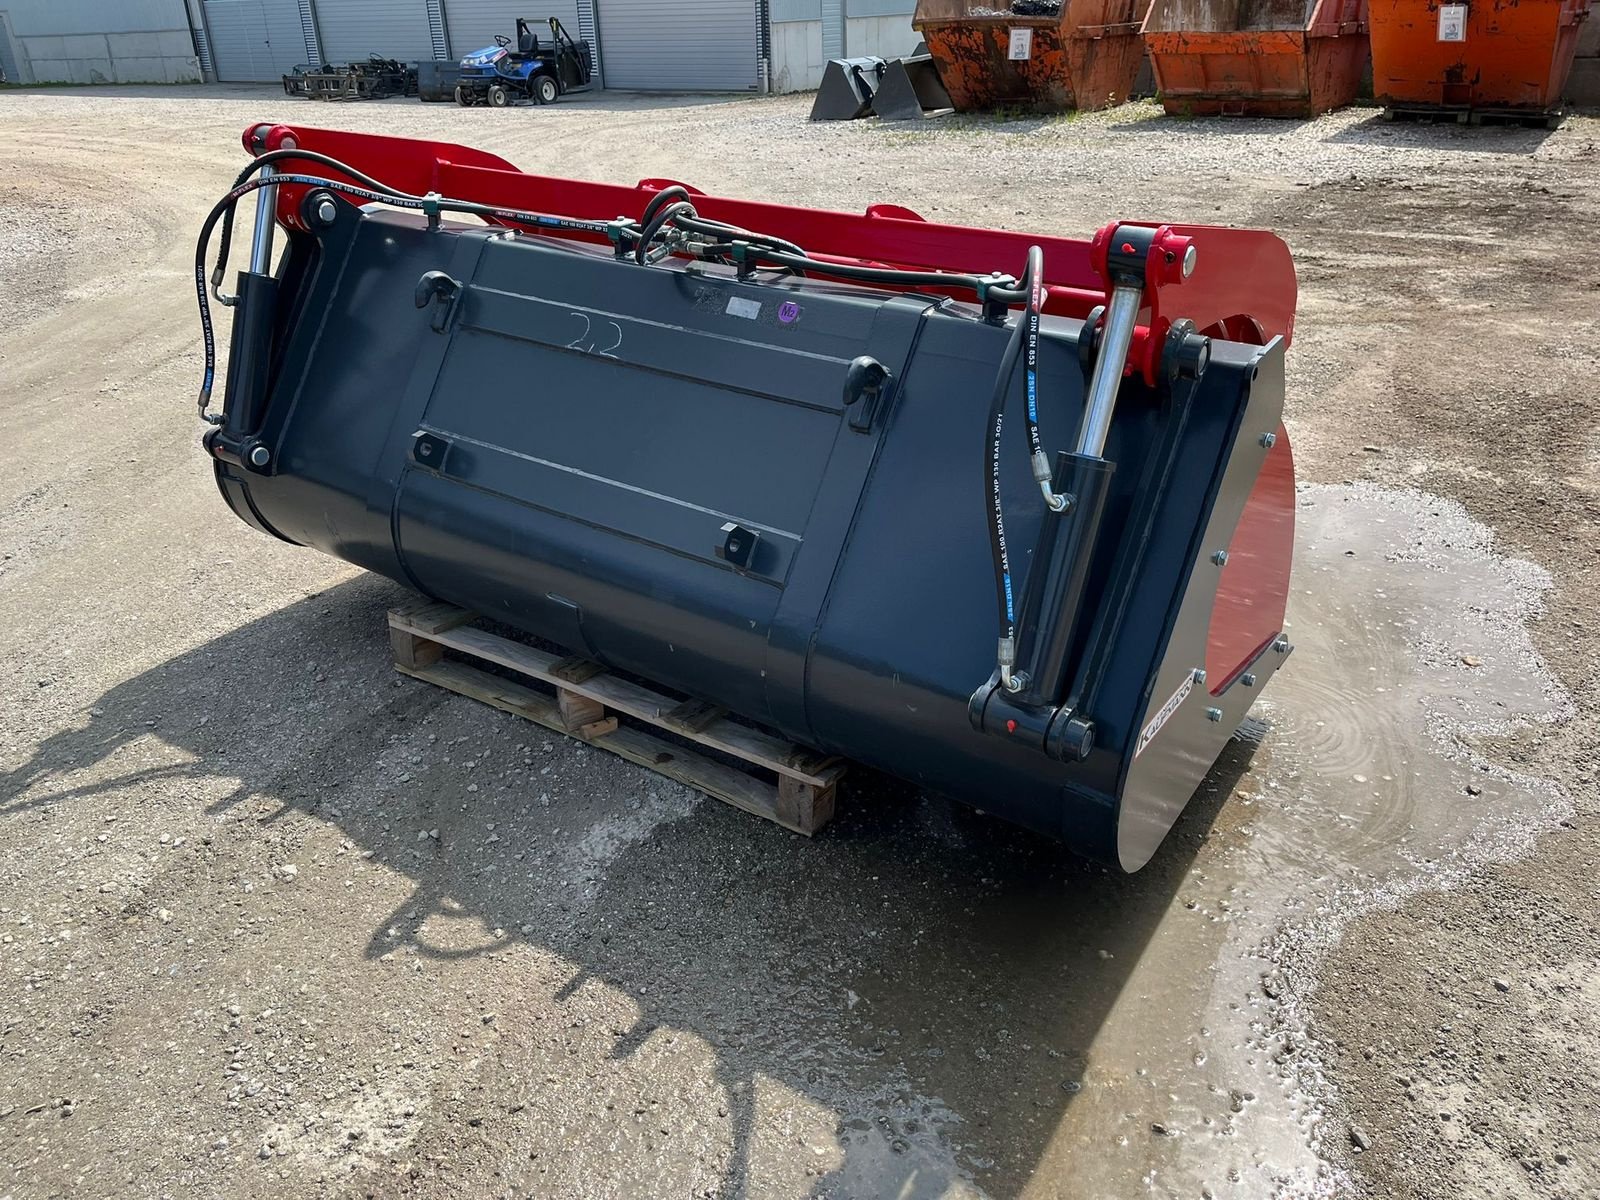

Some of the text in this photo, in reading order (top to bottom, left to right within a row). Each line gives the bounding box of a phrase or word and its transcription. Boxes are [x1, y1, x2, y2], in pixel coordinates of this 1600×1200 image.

[258, 178, 269, 186] DIN
[330, 182, 342, 190] SAE
[782, 305, 795, 318] M2
[1030, 315, 1038, 332] DIN
[1029, 335, 1037, 347] EN
[1031, 426, 1040, 444] SAE
[993, 479, 1000, 494] WP
[996, 513, 1004, 535] R2AT
